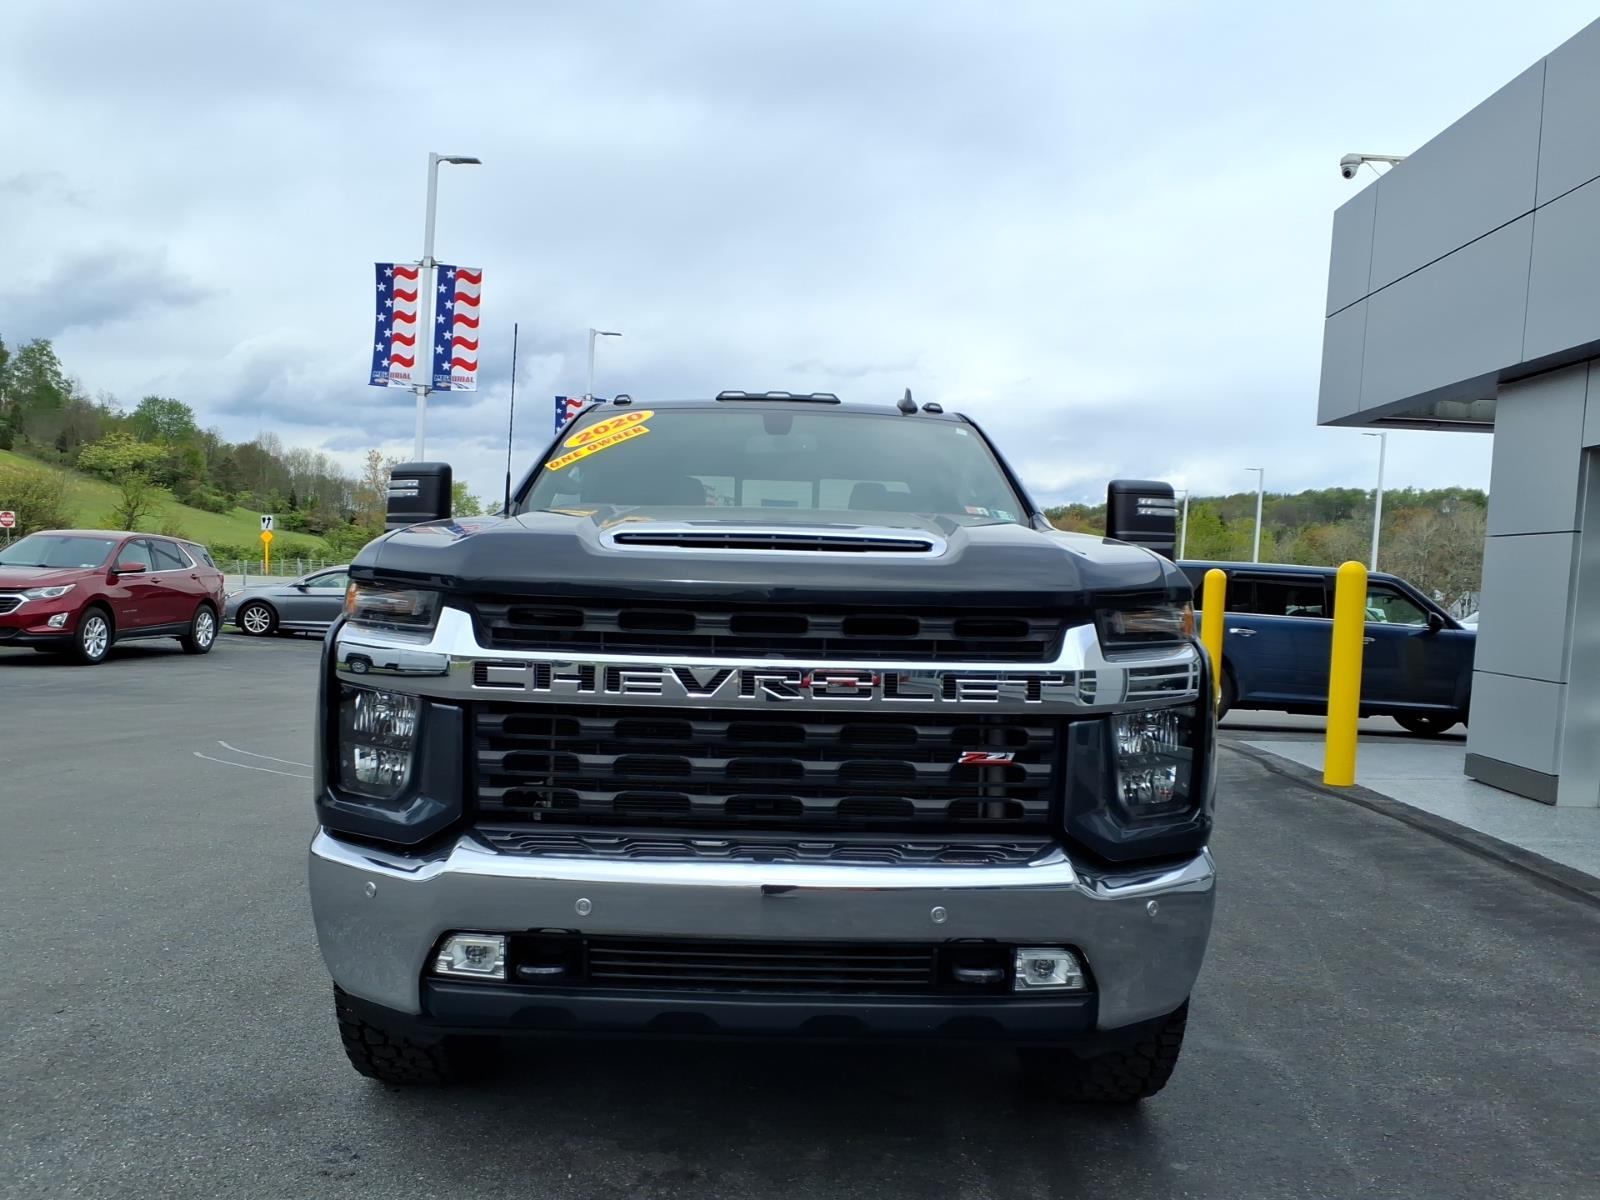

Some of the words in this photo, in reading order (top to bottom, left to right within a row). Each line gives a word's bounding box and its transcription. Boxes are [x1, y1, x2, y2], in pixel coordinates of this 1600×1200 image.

[576, 413, 643, 443] 2020
[550, 450, 582, 468] ONE
[587, 427, 645, 451] OWNER
[471, 660, 1064, 703] CHEVROLET
[957, 751, 1016, 766] Z71
